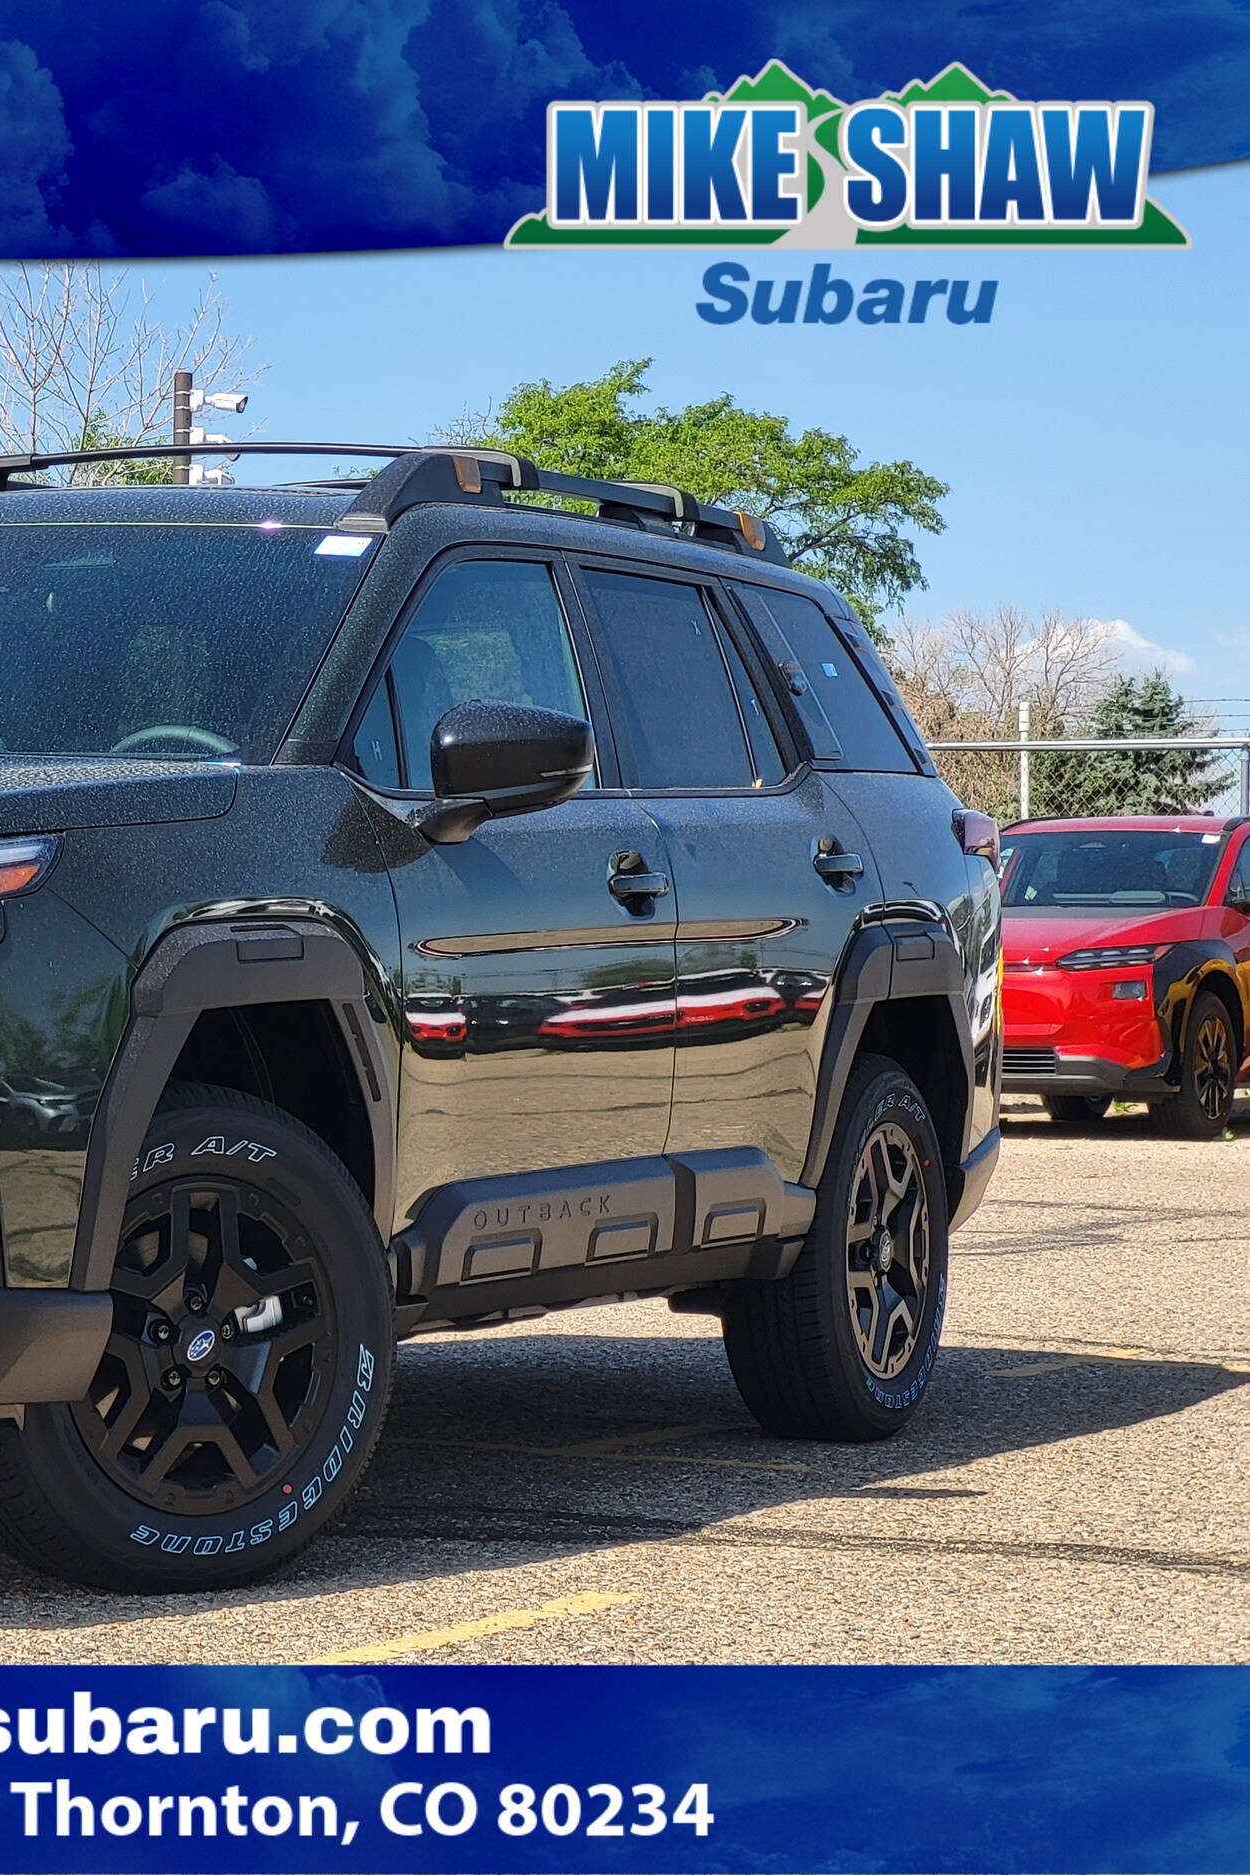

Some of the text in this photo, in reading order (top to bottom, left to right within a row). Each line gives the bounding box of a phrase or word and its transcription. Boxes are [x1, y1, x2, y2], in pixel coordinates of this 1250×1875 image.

[898, 1094, 926, 1122] A/T
[191, 1136, 278, 1163] A/T
[473, 1194, 611, 1230] OUTBACK
[865, 1272, 945, 1409] BRIDGESTONE
[130, 1343, 375, 1555] BRIDGESTONE
